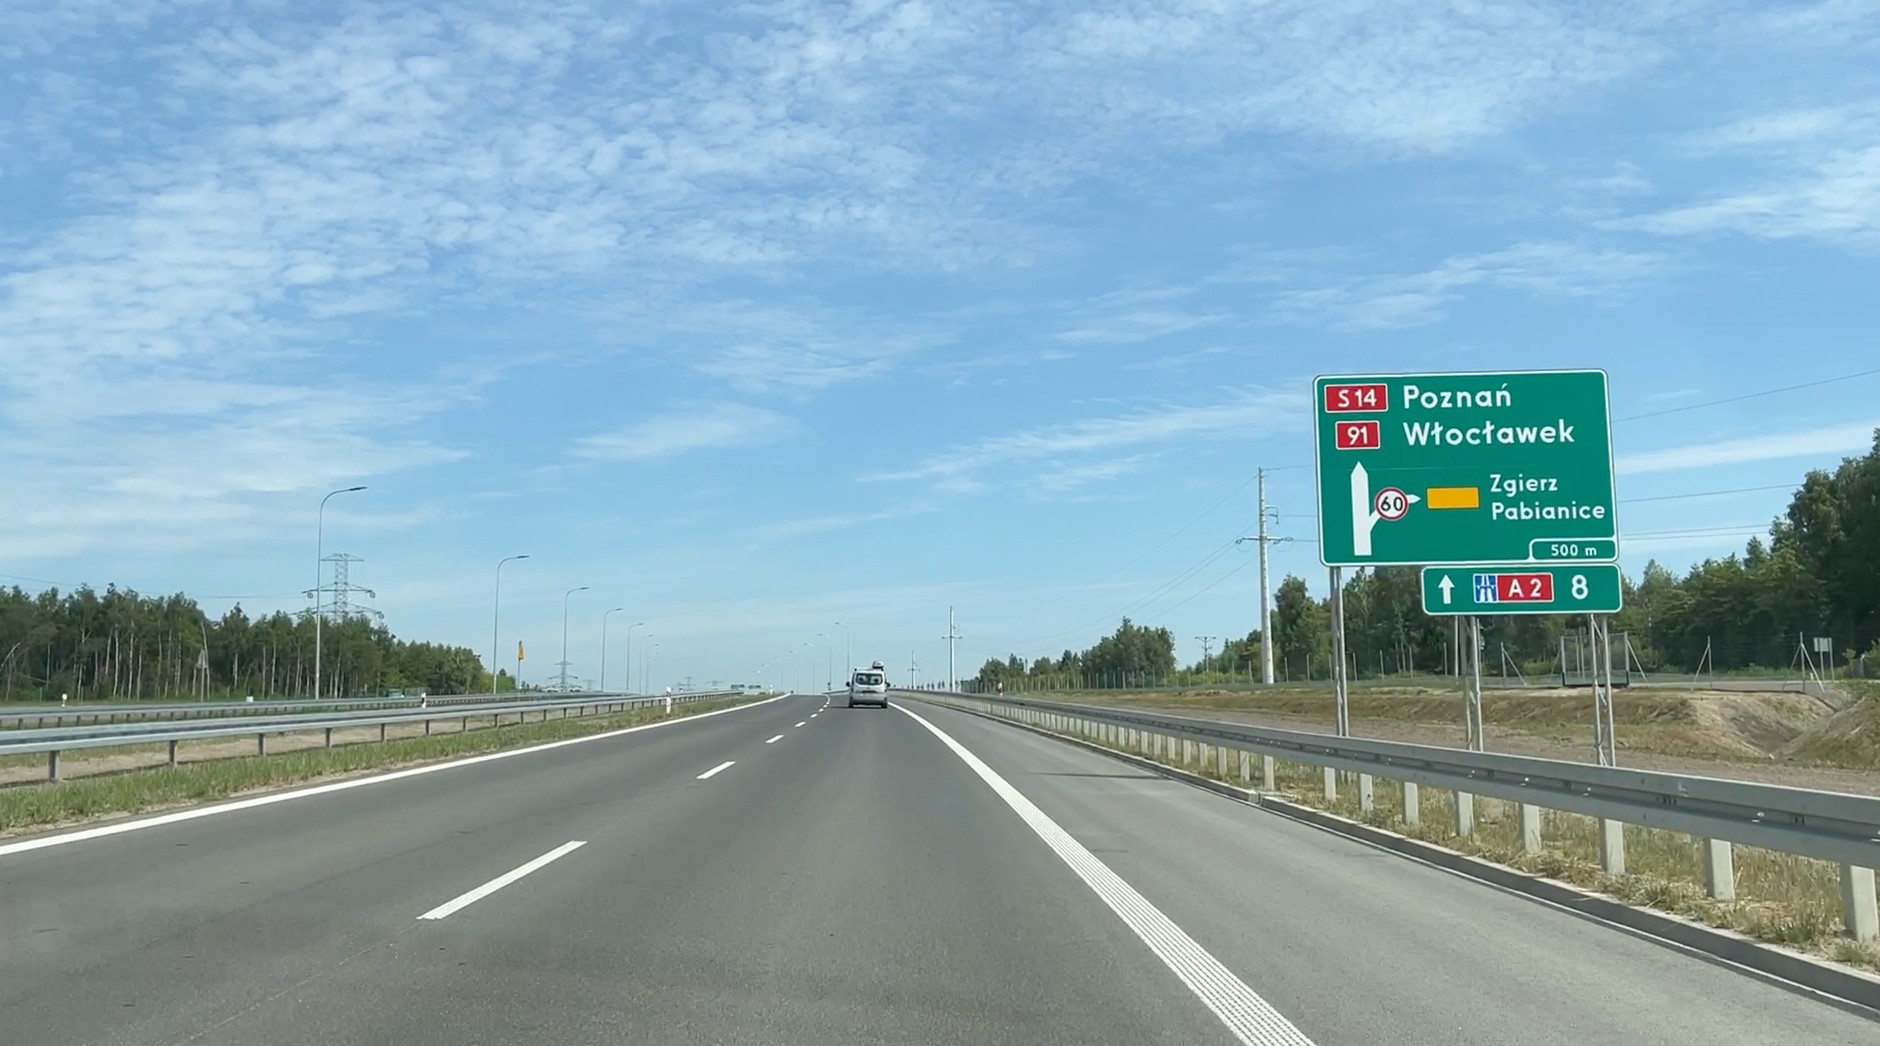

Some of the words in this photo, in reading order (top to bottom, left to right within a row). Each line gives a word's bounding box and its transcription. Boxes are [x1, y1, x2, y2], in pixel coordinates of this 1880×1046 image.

[1403, 383, 1511, 409] Poznań
[1347, 426, 1368, 446] 91
[1403, 419, 1575, 446] Włocławek
[1490, 474, 1558, 498] Zgierz
[1380, 496, 1404, 512] 60
[1492, 501, 1605, 521] Pabianice
[1551, 544, 1578, 557] 500
[1585, 547, 1597, 557] m
[1572, 575, 1589, 600] 8
